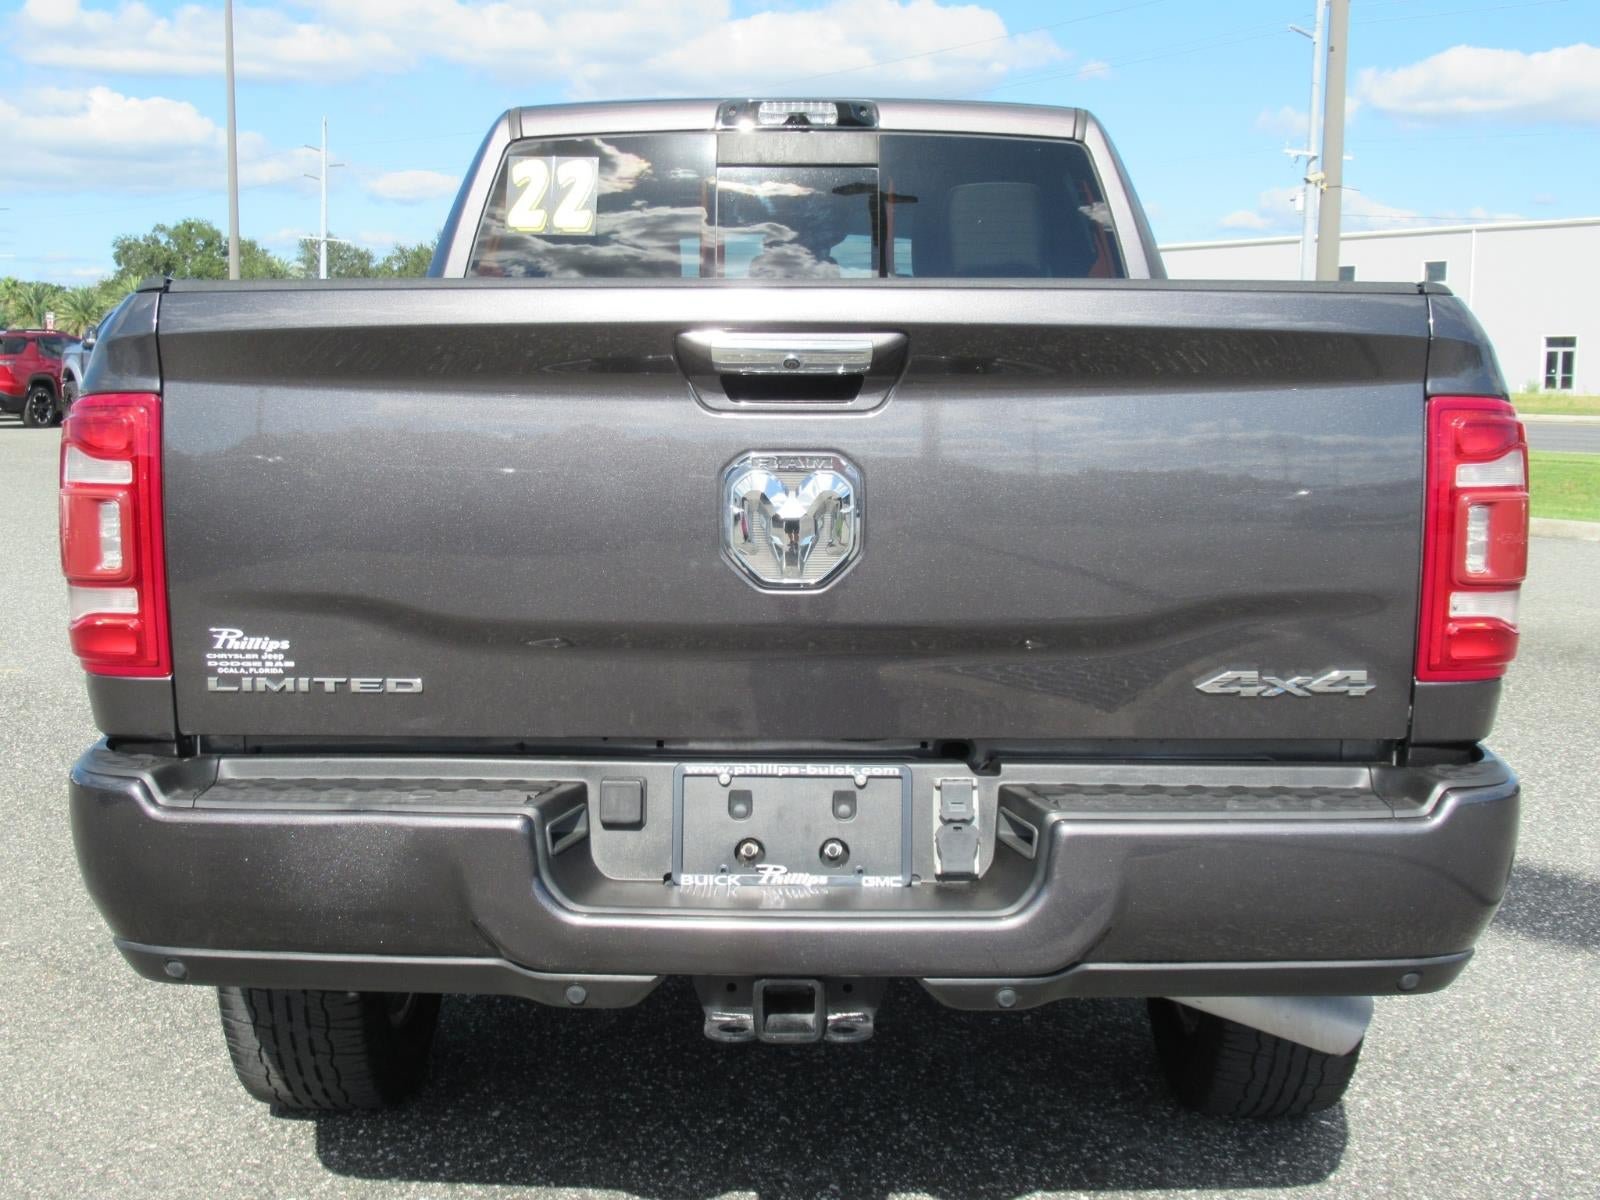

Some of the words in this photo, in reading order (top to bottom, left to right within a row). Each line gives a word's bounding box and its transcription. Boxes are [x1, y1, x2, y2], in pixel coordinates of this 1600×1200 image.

[507, 158, 595, 233] 22
[208, 627, 290, 652] Phillips
[261, 652, 285, 660] Jeep
[207, 677, 423, 693] LIMITED
[685, 765, 899, 775] www.phillips-buick.com
[680, 875, 741, 886] BUICK
[755, 864, 828, 886] Phillips
[862, 876, 903, 887] GMC
